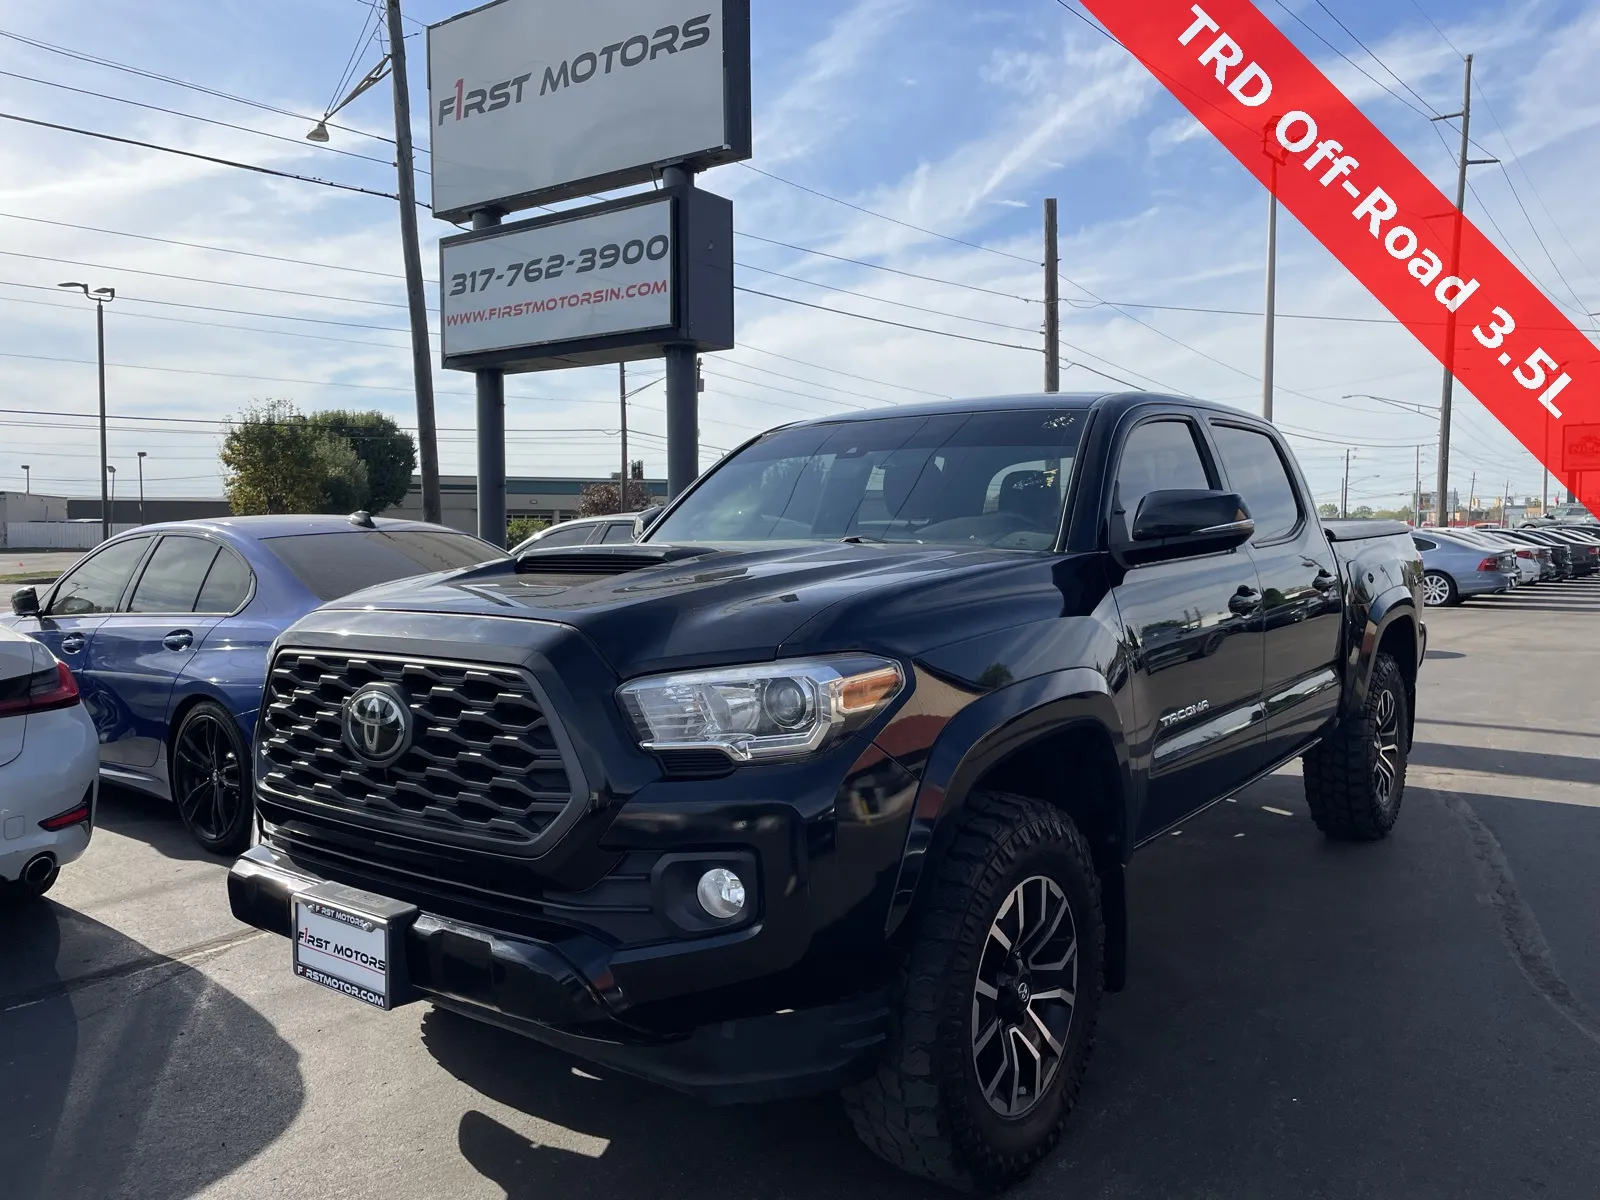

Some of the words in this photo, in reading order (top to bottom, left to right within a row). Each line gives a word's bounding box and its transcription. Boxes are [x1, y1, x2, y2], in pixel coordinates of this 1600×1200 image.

[539, 13, 711, 96] MOTORS
[449, 234, 669, 297] 317-762-3900
[446, 280, 667, 327] WWW.FIRSTMOTORSIN.COM
[1160, 699, 1210, 727] TACOMA
[335, 913, 365, 927] MOTORS
[333, 943, 385, 971] MOTORS
